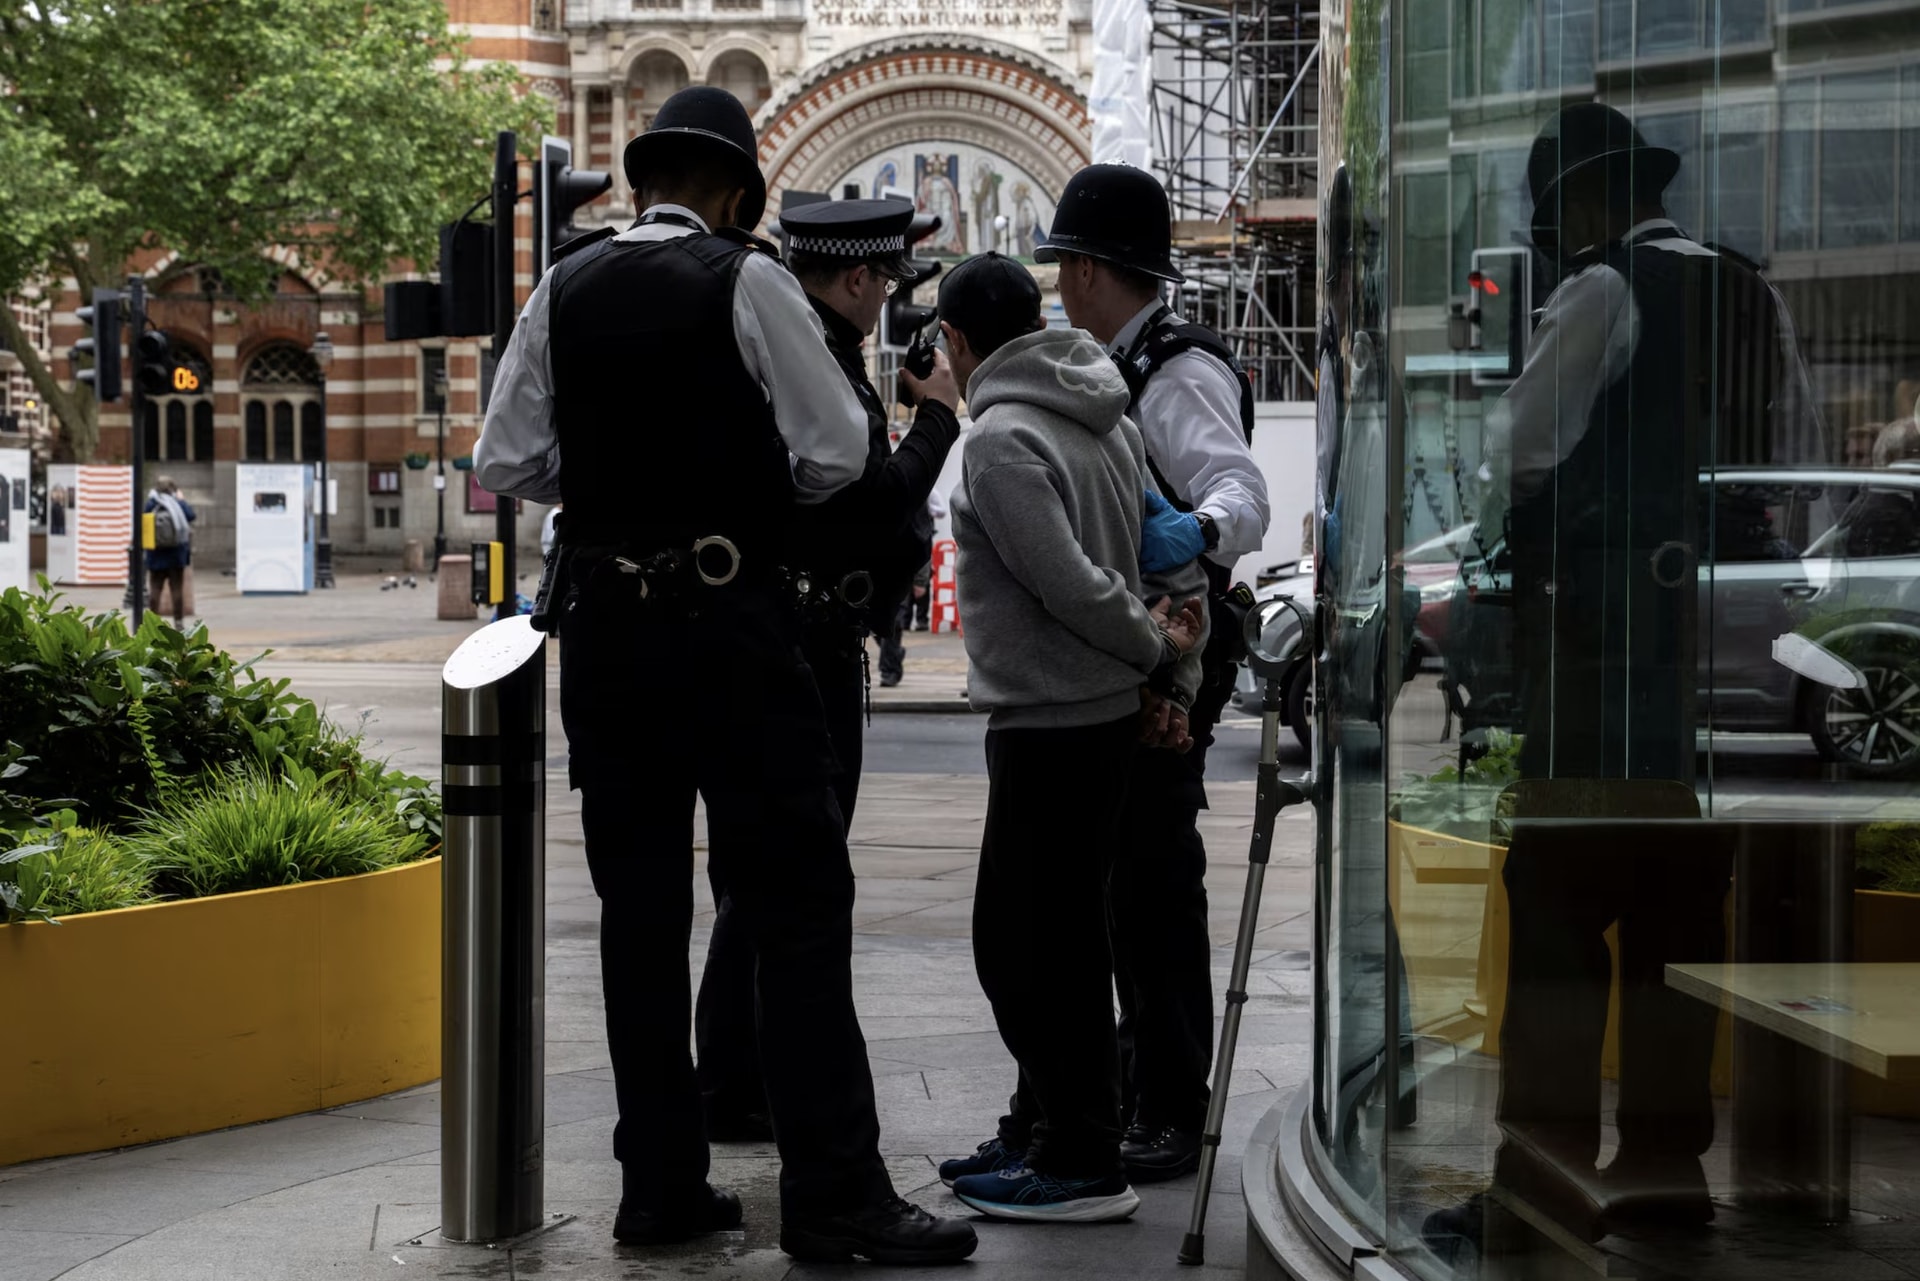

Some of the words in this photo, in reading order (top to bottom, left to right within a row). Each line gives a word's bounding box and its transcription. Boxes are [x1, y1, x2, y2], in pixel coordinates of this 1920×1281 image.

[818, 12, 842, 26] PER
[1028, 12, 1060, 26] NOS
[174, 367, 199, 390] 06
